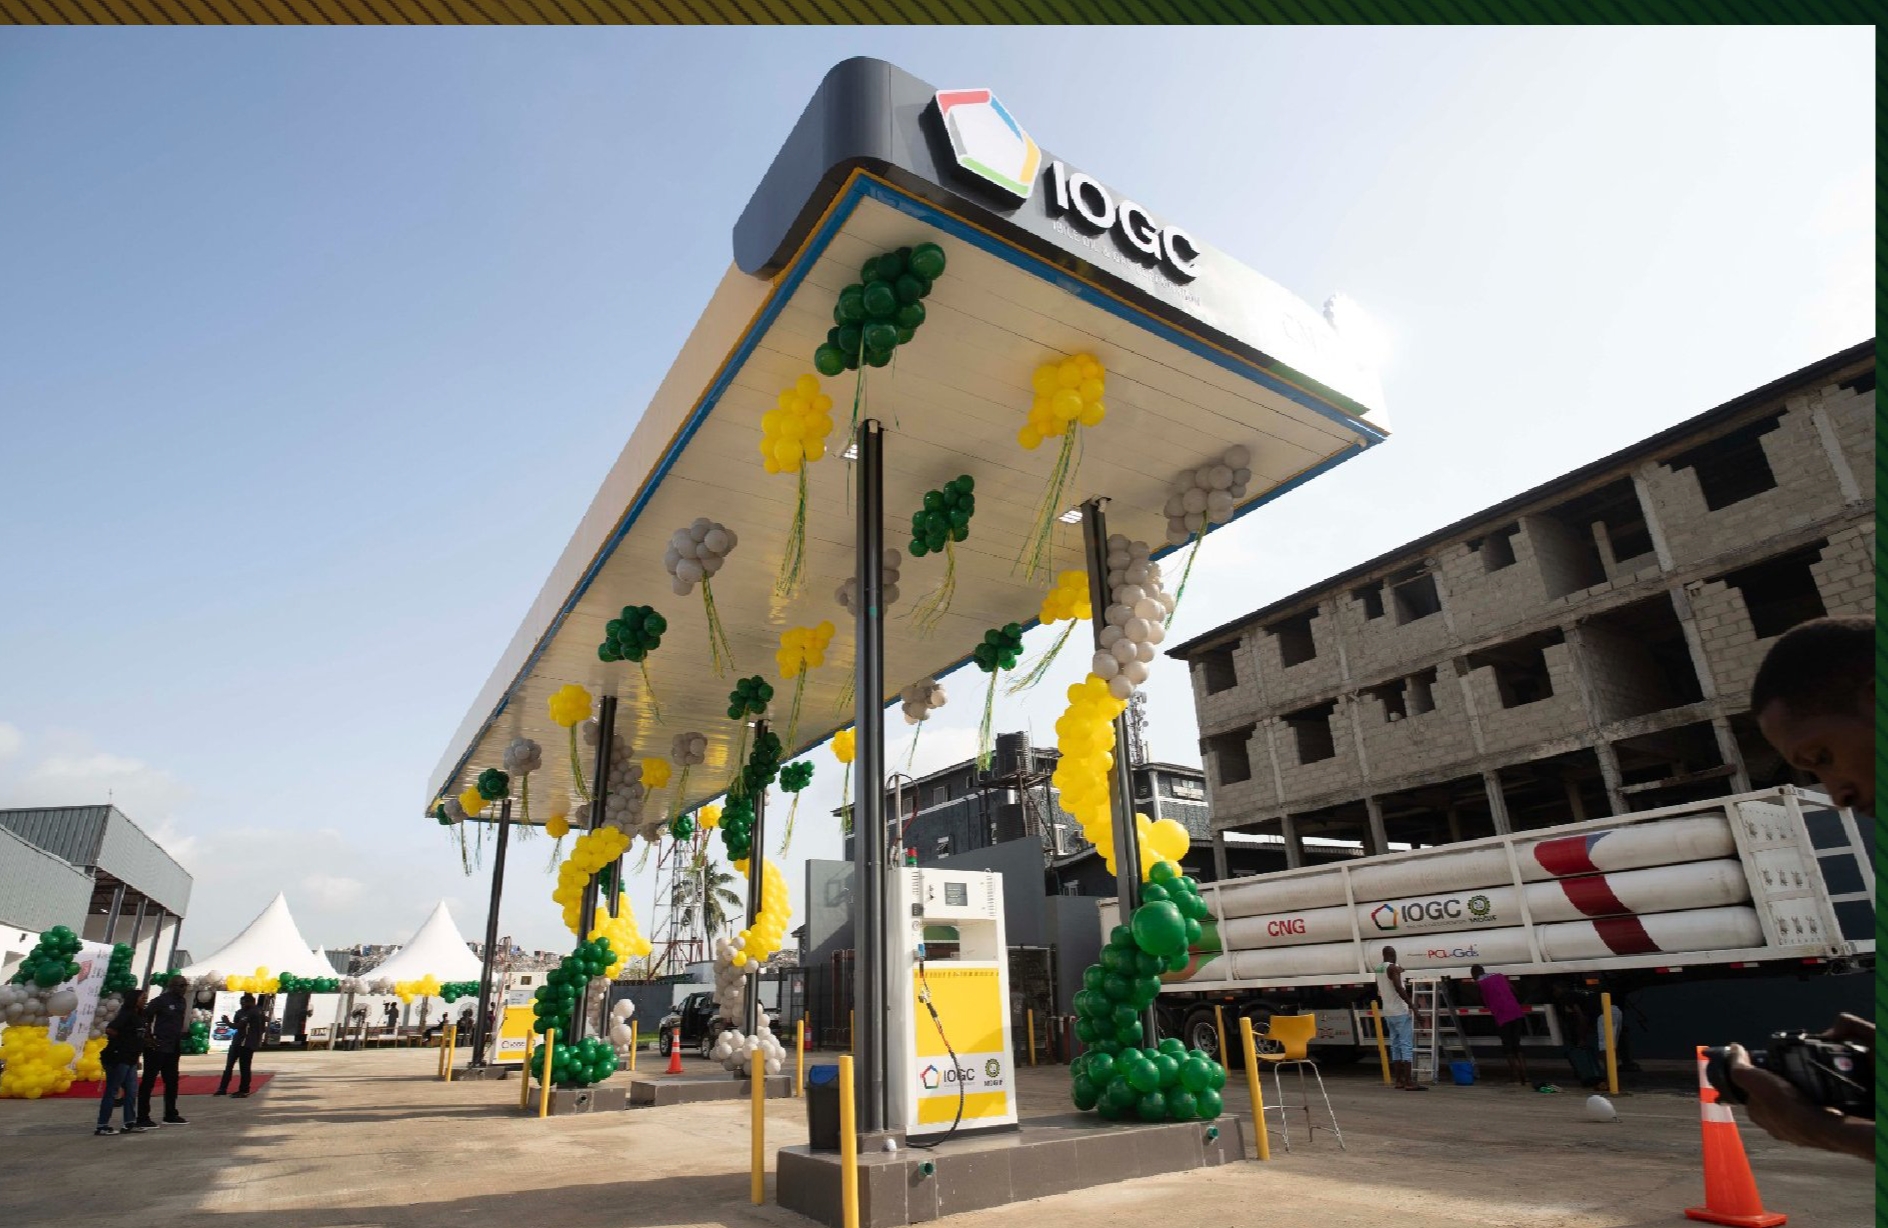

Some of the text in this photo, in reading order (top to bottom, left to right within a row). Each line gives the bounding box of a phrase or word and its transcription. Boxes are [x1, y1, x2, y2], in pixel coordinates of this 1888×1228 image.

[1051, 159, 1201, 279] IOGC
[1401, 899, 1462, 923] IOGC
[1268, 918, 1306, 937] CNG
[943, 1068, 975, 1082] IOGC
